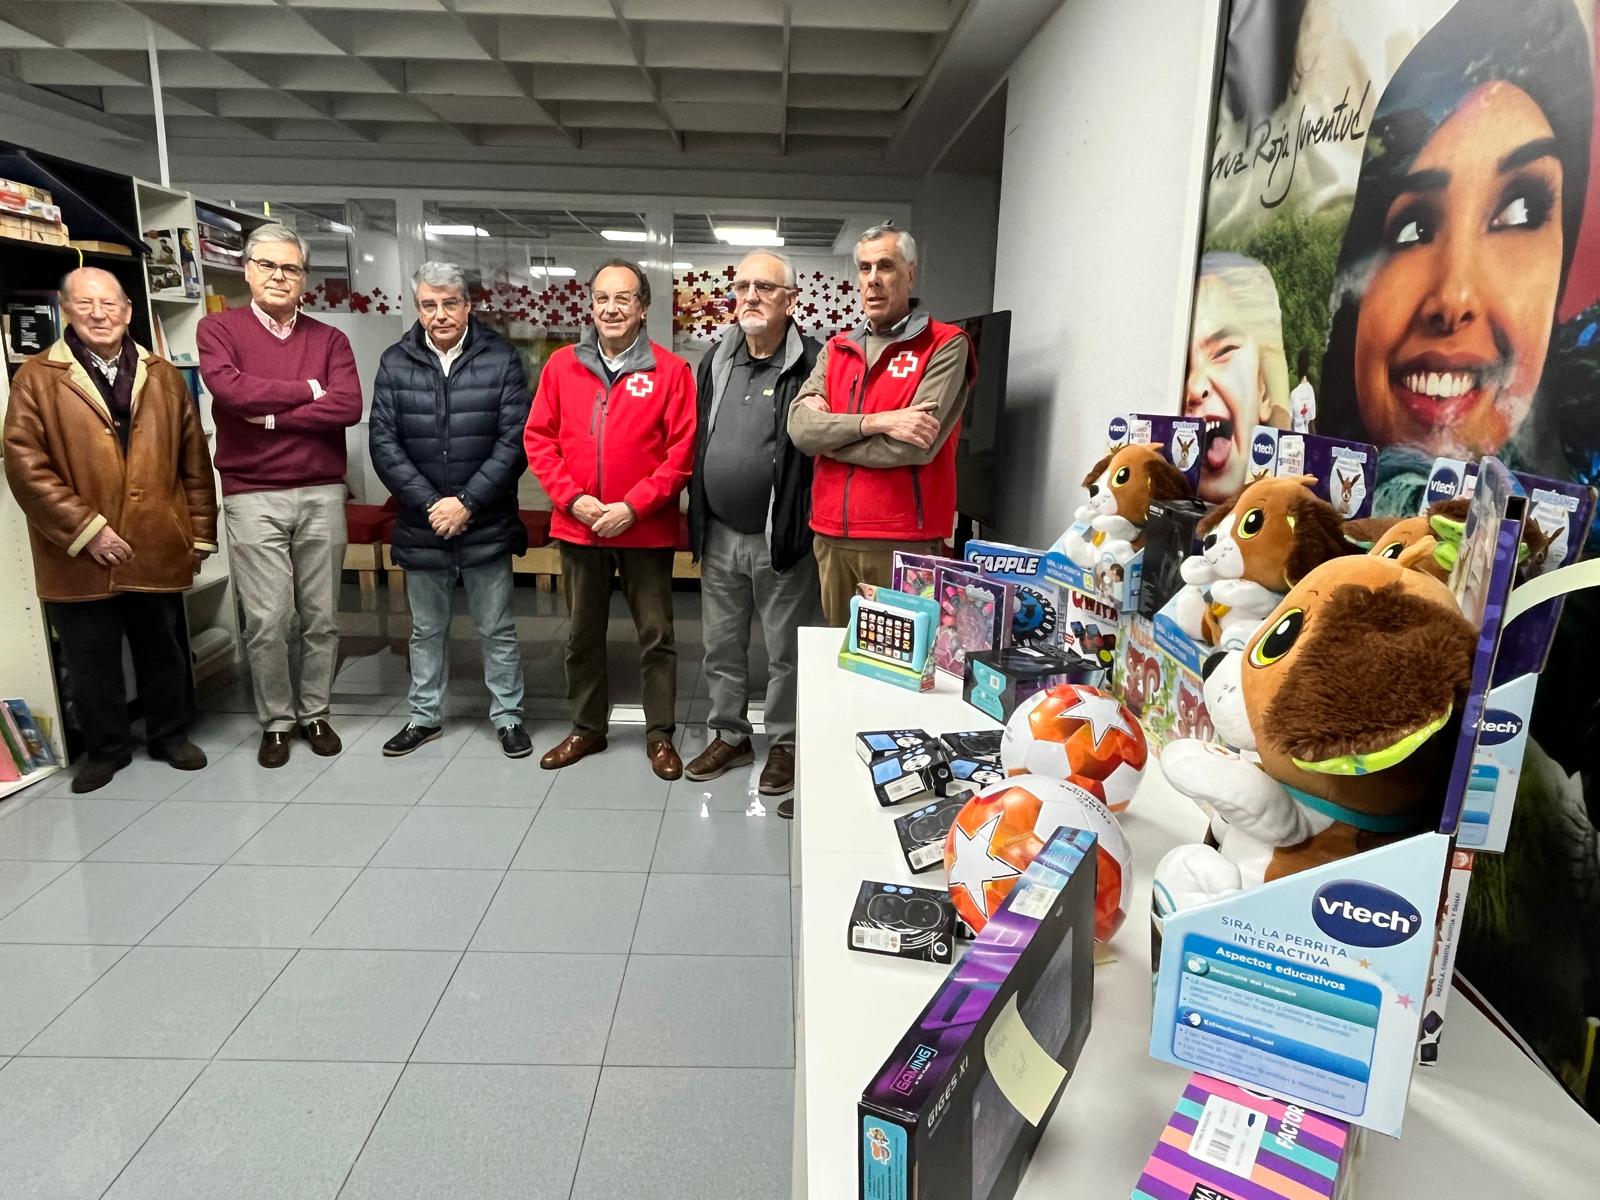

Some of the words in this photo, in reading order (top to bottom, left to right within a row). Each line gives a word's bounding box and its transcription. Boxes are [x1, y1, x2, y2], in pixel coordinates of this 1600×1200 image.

[1253, 118, 1289, 188] Roja
[1260, 80, 1371, 209] Juventud
[1109, 424, 1127, 433] vtech
[1253, 443, 1274, 455] vtech
[1430, 480, 1456, 496] vtech
[974, 555, 1039, 574] TAPPLE
[1319, 896, 1411, 934] vtech
[1221, 916, 1257, 935] SIRA,
[1262, 927, 1280, 940] LA
[1285, 934, 1348, 959] PERRITA
[1233, 932, 1331, 968] INTERACTIVA
[1216, 946, 1273, 971] Aspectos
[1275, 965, 1347, 992] educativos
[896, 1048, 932, 1091] GAMING
[927, 1073, 958, 1128] GIGES
[1275, 1104, 1305, 1151] FACTOR
